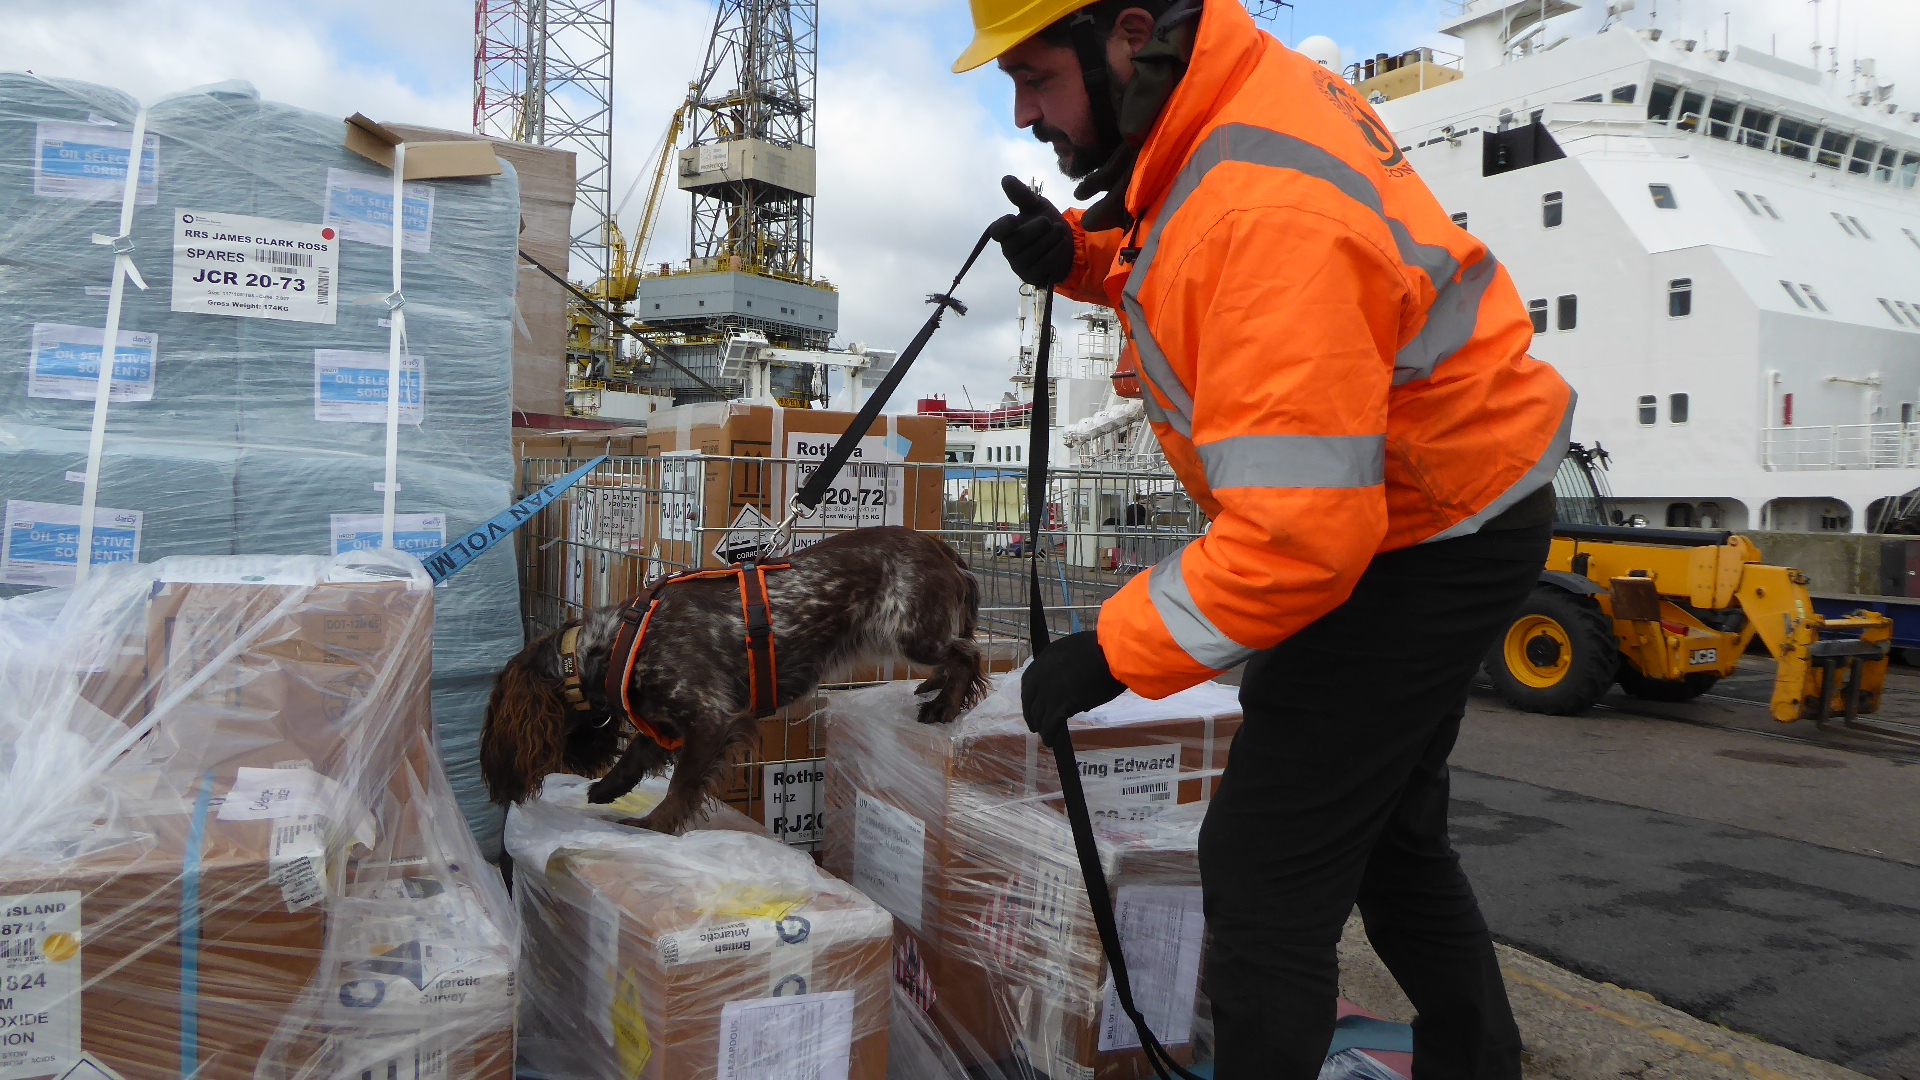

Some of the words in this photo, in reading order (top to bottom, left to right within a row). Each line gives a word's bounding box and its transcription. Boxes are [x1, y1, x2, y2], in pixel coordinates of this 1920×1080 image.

[60, 149, 81, 160] OIL
[368, 198, 426, 215] SELETIVE
[185, 229, 208, 239] RRS
[212, 232, 251, 243] JAMES
[255, 237, 294, 248] CLARK
[298, 241, 328, 252] ROSS
[187, 248, 245, 263] SPARES
[193, 268, 238, 286] JCR
[246, 273, 306, 292] 20-73
[232, 301, 261, 309] Weight:
[264, 304, 289, 312] 174KG
[55, 350, 76, 360] OIL
[80, 351, 148, 365] SELTIVE
[335, 374, 354, 384] OIL
[508, 483, 555, 522] JAN
[30, 531, 54, 542] OIL
[353, 539, 371, 550] OIL
[1689, 649, 1717, 664] JCB
[1114, 754, 1175, 773] Edward
[773, 769, 824, 786] Rothe
[773, 792, 797, 804] Haz
[6, 902, 67, 918] ISLAND
[700, 928, 750, 942] Antarctic
[715, 940, 751, 954] British
[420, 990, 467, 1004] Survey
[0, 1011, 49, 1029] OXIDE
[2, 1050, 28, 1060] STOW
[727, 1020, 739, 1078] HAZARDOUS
[31, 1055, 56, 1064] ACIDS
